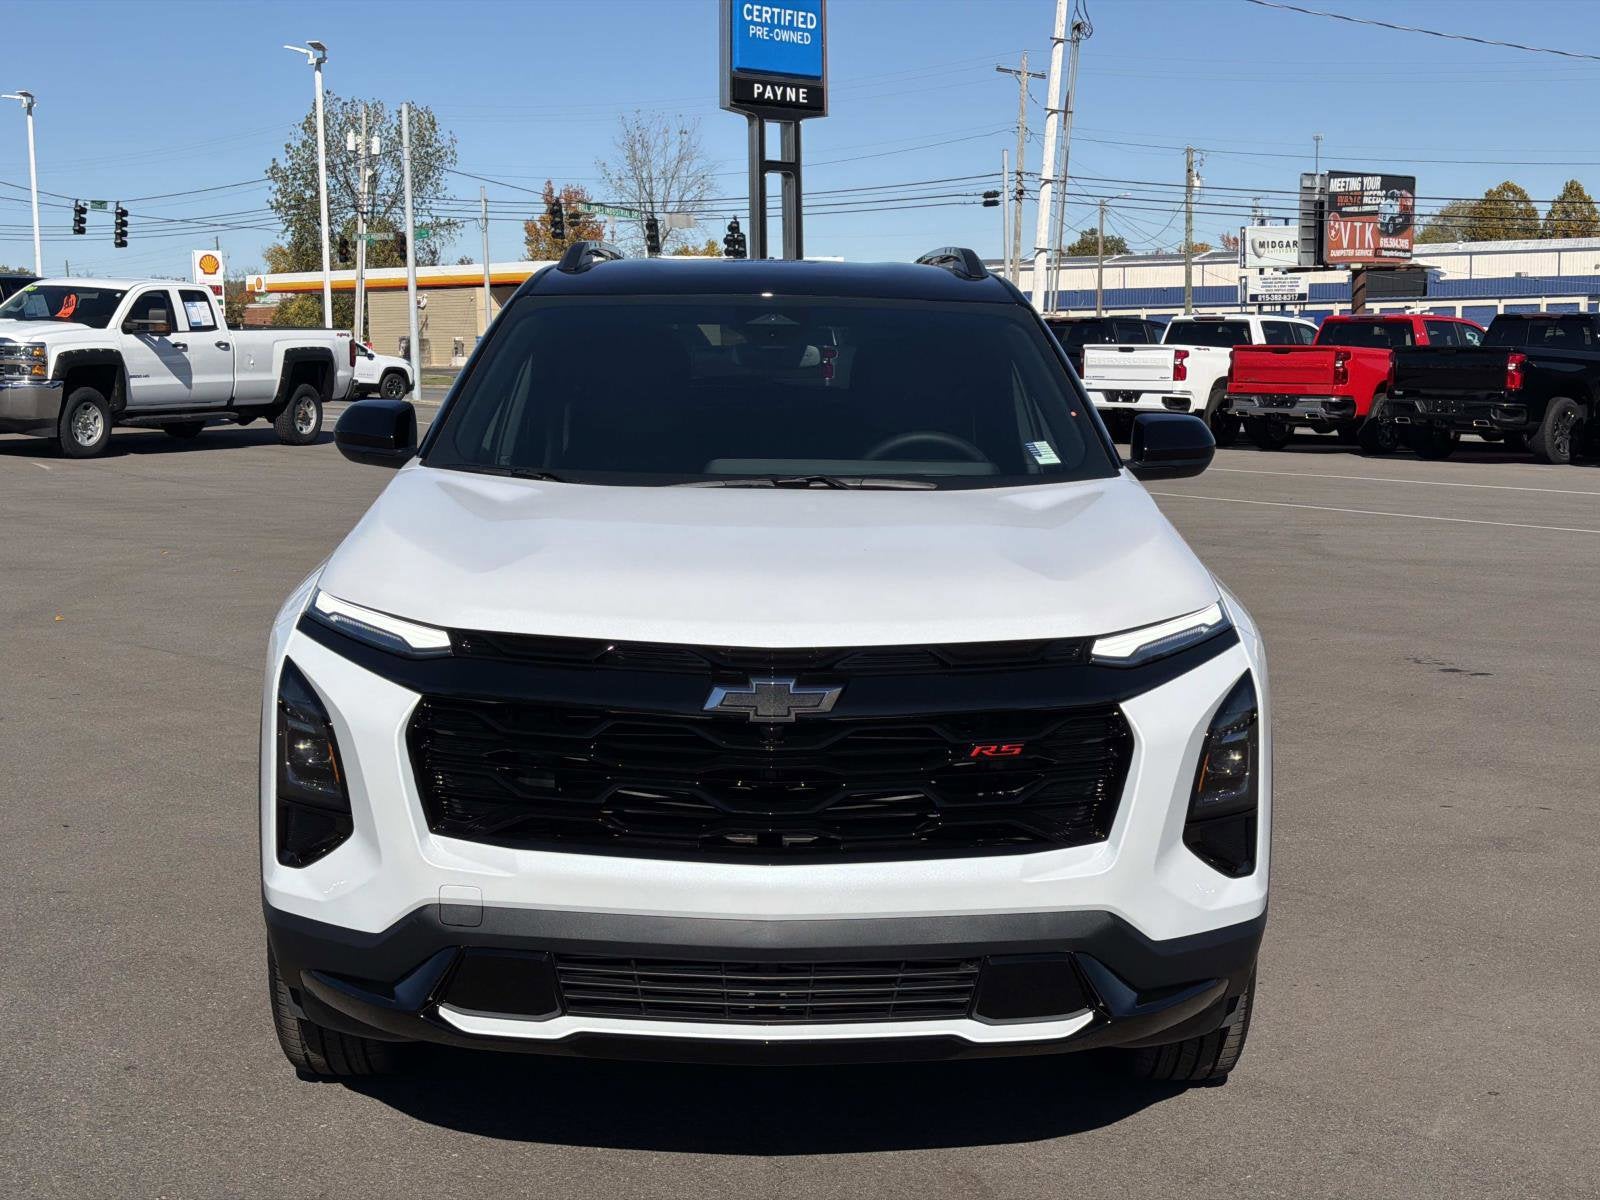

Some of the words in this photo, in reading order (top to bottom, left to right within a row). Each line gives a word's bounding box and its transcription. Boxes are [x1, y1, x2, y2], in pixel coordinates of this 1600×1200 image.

[743, 3, 817, 29] CERTIFIED
[749, 25, 811, 45] PRE-OWNED
[753, 83, 808, 103] PAYNE
[1329, 177, 1361, 192] MEETING
[1363, 176, 1381, 190] YOUR
[1340, 222, 1375, 249] VTK
[1330, 249, 1354, 257] DUMPSTER
[1355, 249, 1373, 257] SERVICE
[970, 743, 1024, 757] RS
